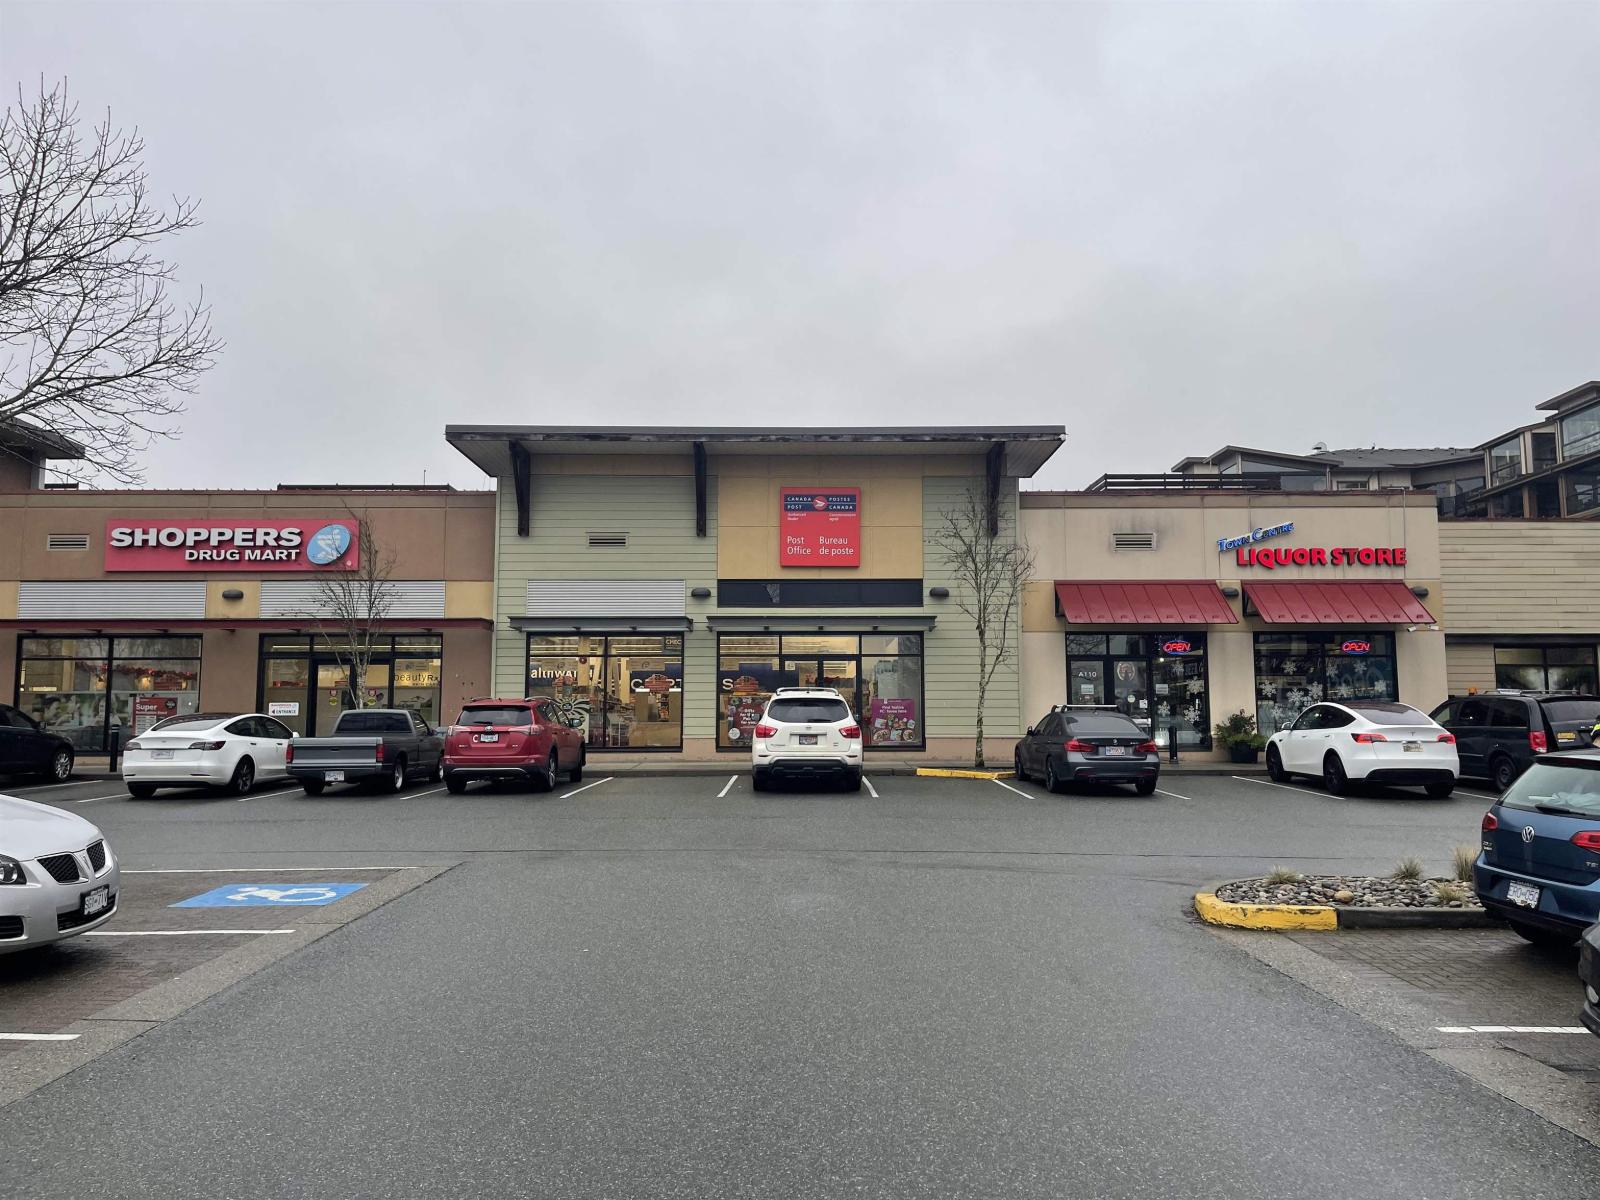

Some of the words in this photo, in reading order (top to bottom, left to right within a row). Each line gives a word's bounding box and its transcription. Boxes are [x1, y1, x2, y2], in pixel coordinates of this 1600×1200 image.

[109, 527, 302, 547] SHOPPERS
[787, 536, 805, 545] Post
[819, 536, 848, 545] Bureau
[184, 549, 240, 561] DRUG
[244, 549, 300, 561] MART
[787, 546, 812, 555] Office
[819, 546, 829, 555] de
[831, 547, 854, 556] poste
[1237, 548, 1328, 569] LIQUOR
[1331, 548, 1407, 566] STORE
[1163, 642, 1192, 652] OPEN
[1342, 642, 1371, 652] OPEN
[135, 703, 158, 712] Super
